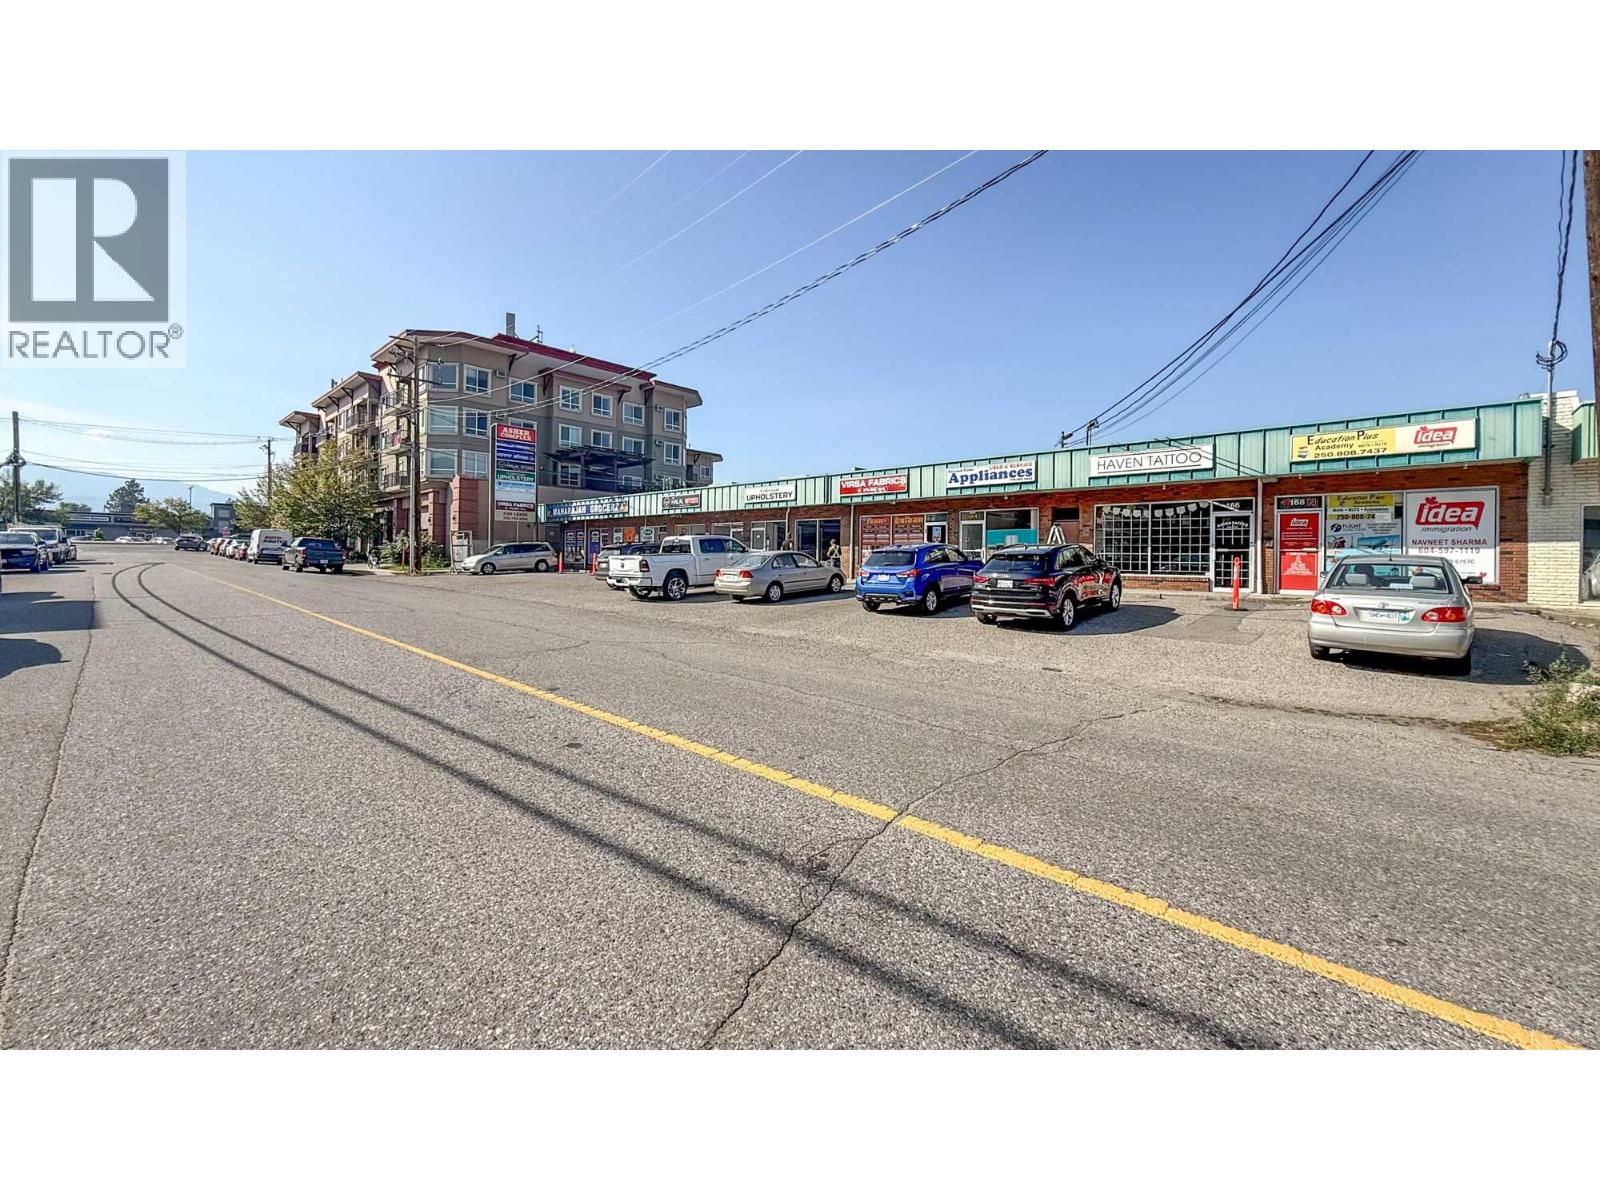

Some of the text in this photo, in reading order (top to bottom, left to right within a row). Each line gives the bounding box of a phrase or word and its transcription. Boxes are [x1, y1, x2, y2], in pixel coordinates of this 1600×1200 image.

[1307, 430, 1380, 446] Education Plus
[1416, 429, 1455, 443] idea
[1314, 442, 1354, 451] Academy
[1097, 451, 1202, 471] HAVEN TATTOO
[841, 476, 906, 489] VIRSA FABRICS
[948, 468, 1033, 485] Appliances
[746, 491, 793, 501] UPHOLSTERY
[1420, 504, 1479, 522] idea
[1421, 526, 1472, 534] immigration
[1411, 538, 1487, 546] NAVNEET SHARMA
